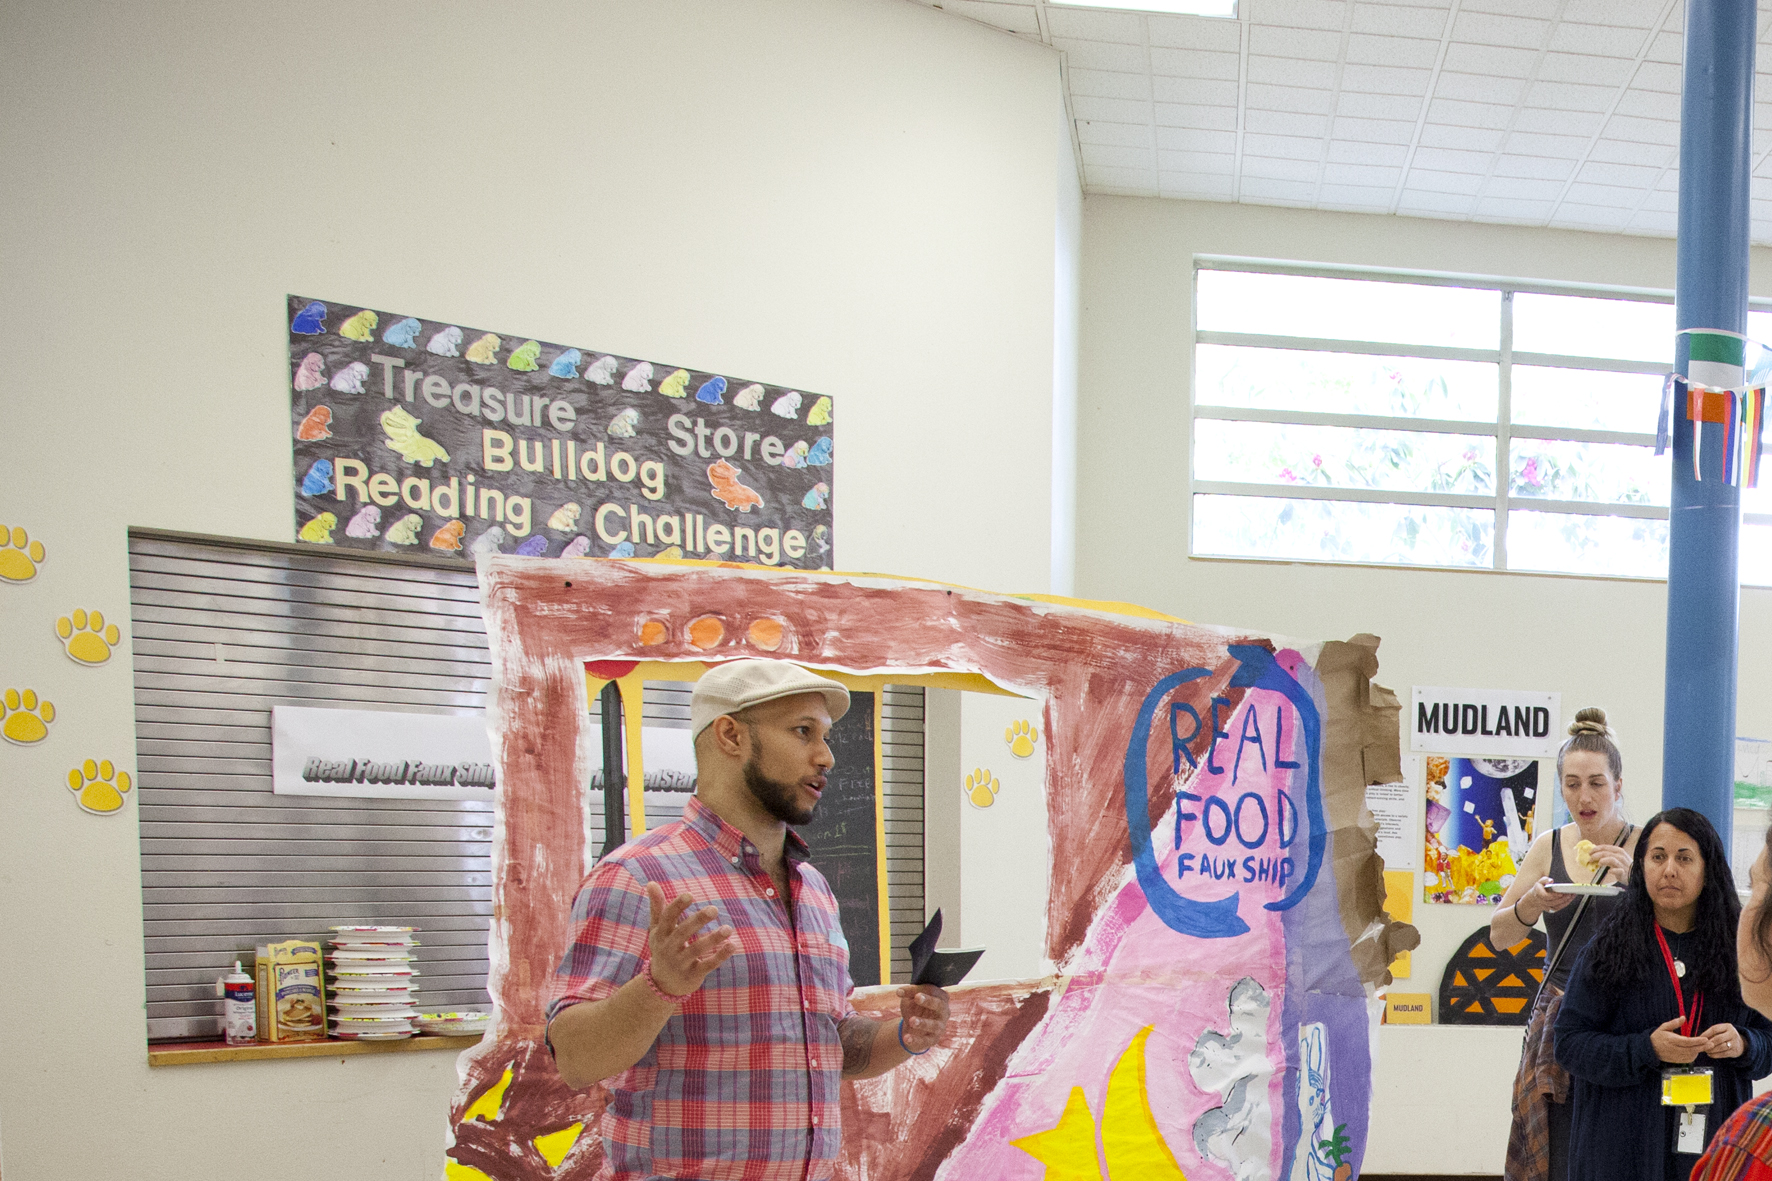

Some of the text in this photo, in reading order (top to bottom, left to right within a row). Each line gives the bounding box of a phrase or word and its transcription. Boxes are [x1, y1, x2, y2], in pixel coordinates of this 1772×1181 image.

[371, 354, 785, 466] Treasure Store
[483, 429, 666, 500] Bulldog
[333, 457, 807, 566] Reading Challenge
[1170, 697, 1300, 786] REAL
[1417, 702, 1550, 739] MUDLAND
[302, 756, 356, 783] Real
[354, 758, 408, 785] Food
[405, 760, 457, 787] Faux
[1175, 789, 1299, 850] FOOD
[1393, 1004, 1424, 1012] MUDLAND
